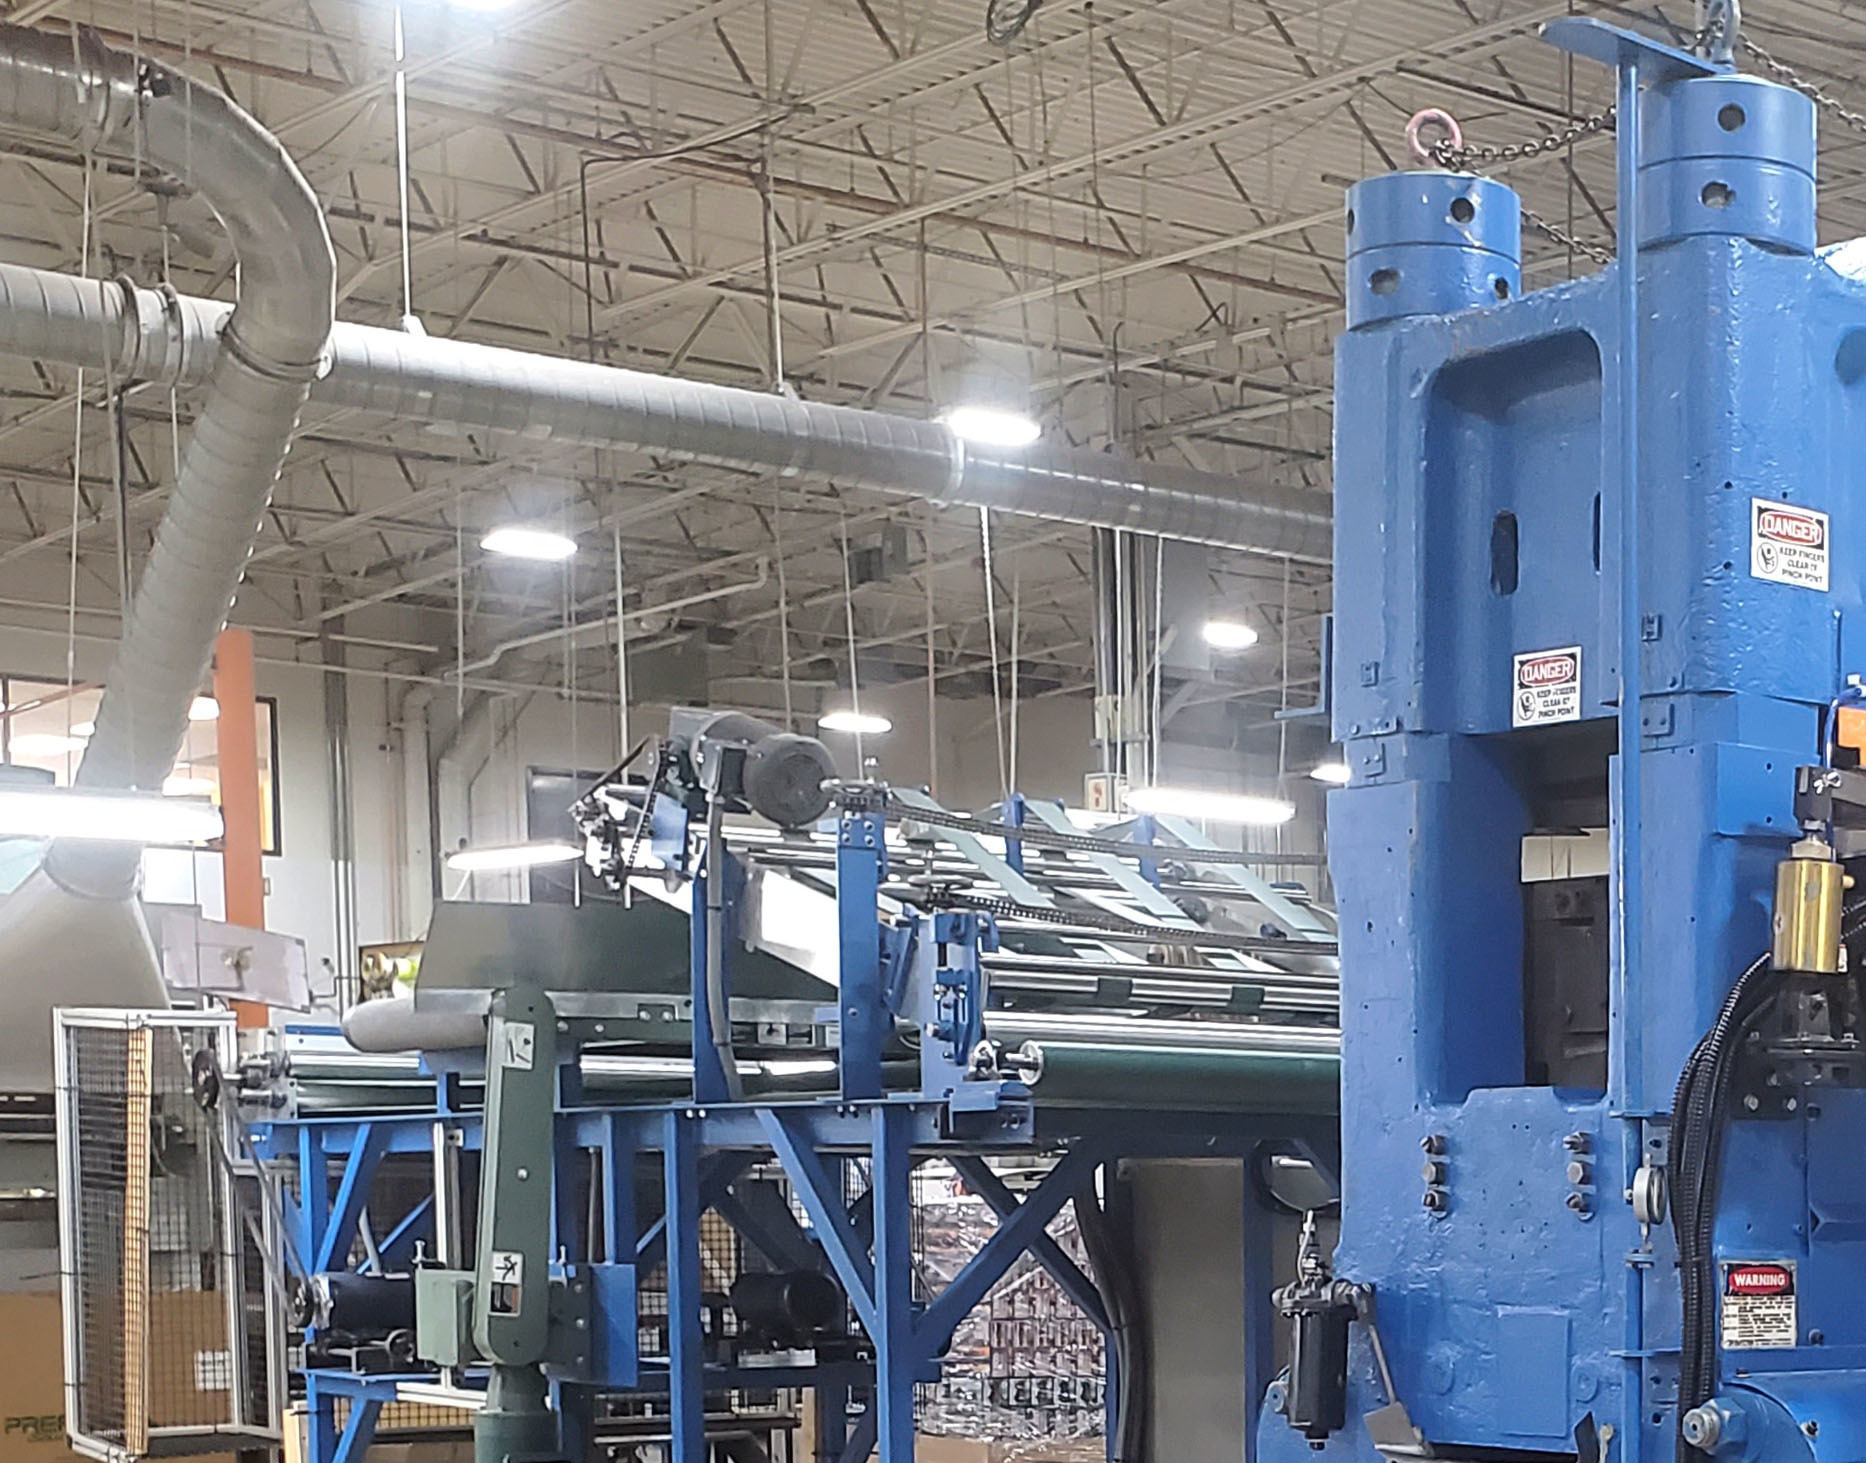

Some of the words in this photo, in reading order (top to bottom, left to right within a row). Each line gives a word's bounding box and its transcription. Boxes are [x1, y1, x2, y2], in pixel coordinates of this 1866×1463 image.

[1763, 515, 1818, 543] DANGER
[1524, 660, 1571, 683] DANGER
[1733, 1273, 1786, 1287] WARNING
